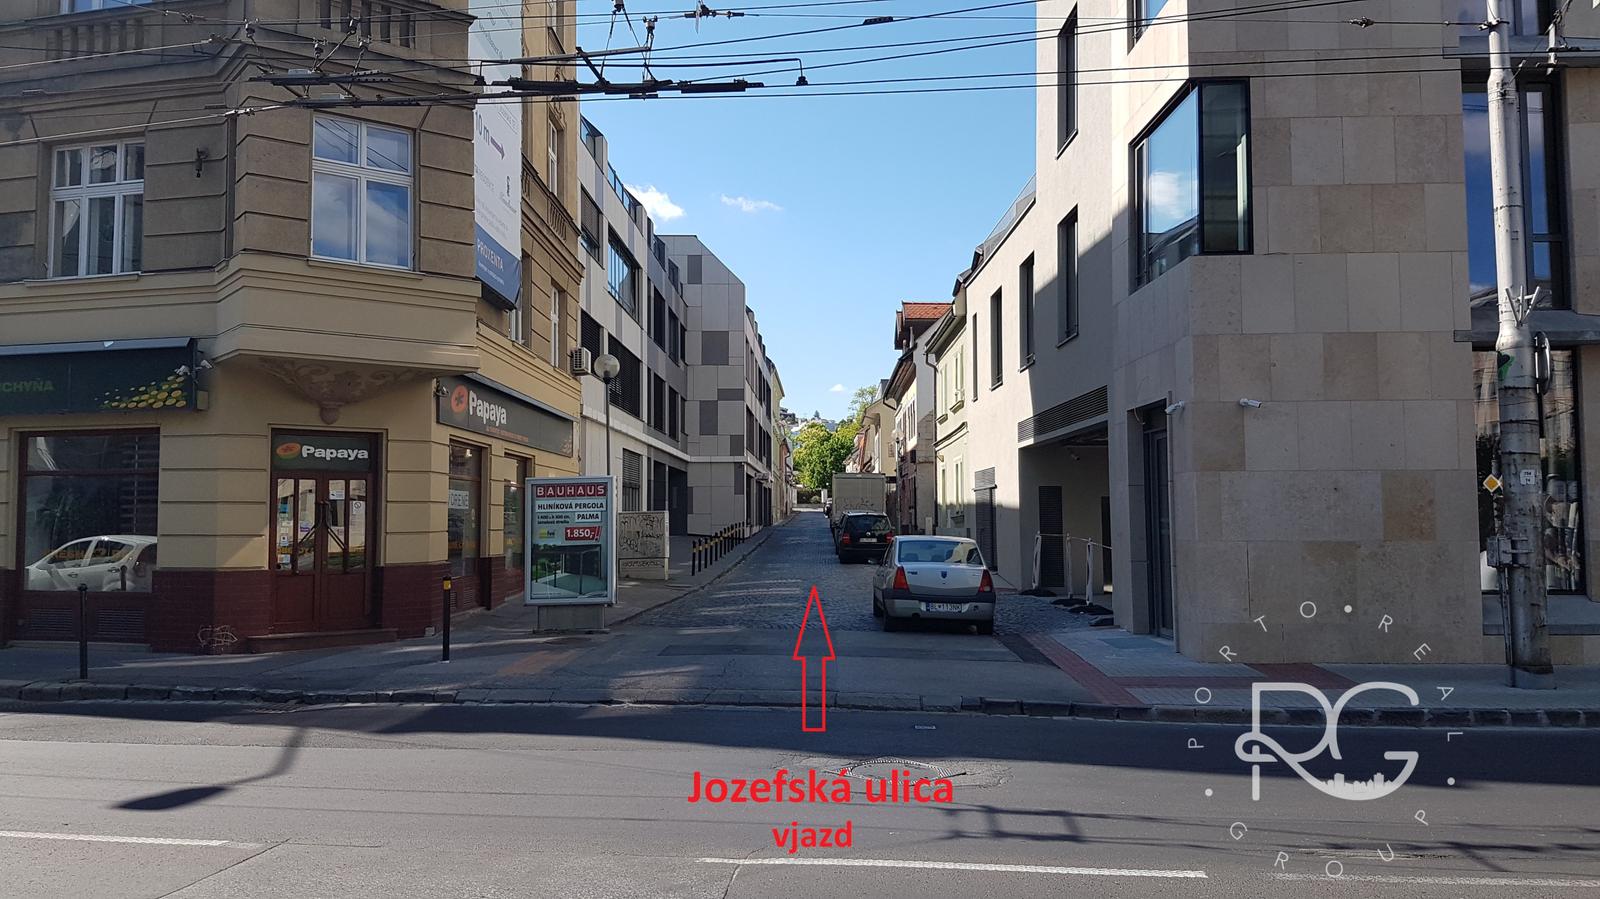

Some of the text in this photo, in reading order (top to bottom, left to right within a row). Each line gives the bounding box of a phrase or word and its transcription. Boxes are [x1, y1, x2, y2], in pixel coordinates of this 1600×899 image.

[0, 377, 55, 393] CHYŇA
[469, 390, 507, 427] Papaya
[301, 445, 369, 461] Papaya
[537, 485, 605, 496] BAUHAUS
[537, 502, 573, 510] HLINÍKOVÁ
